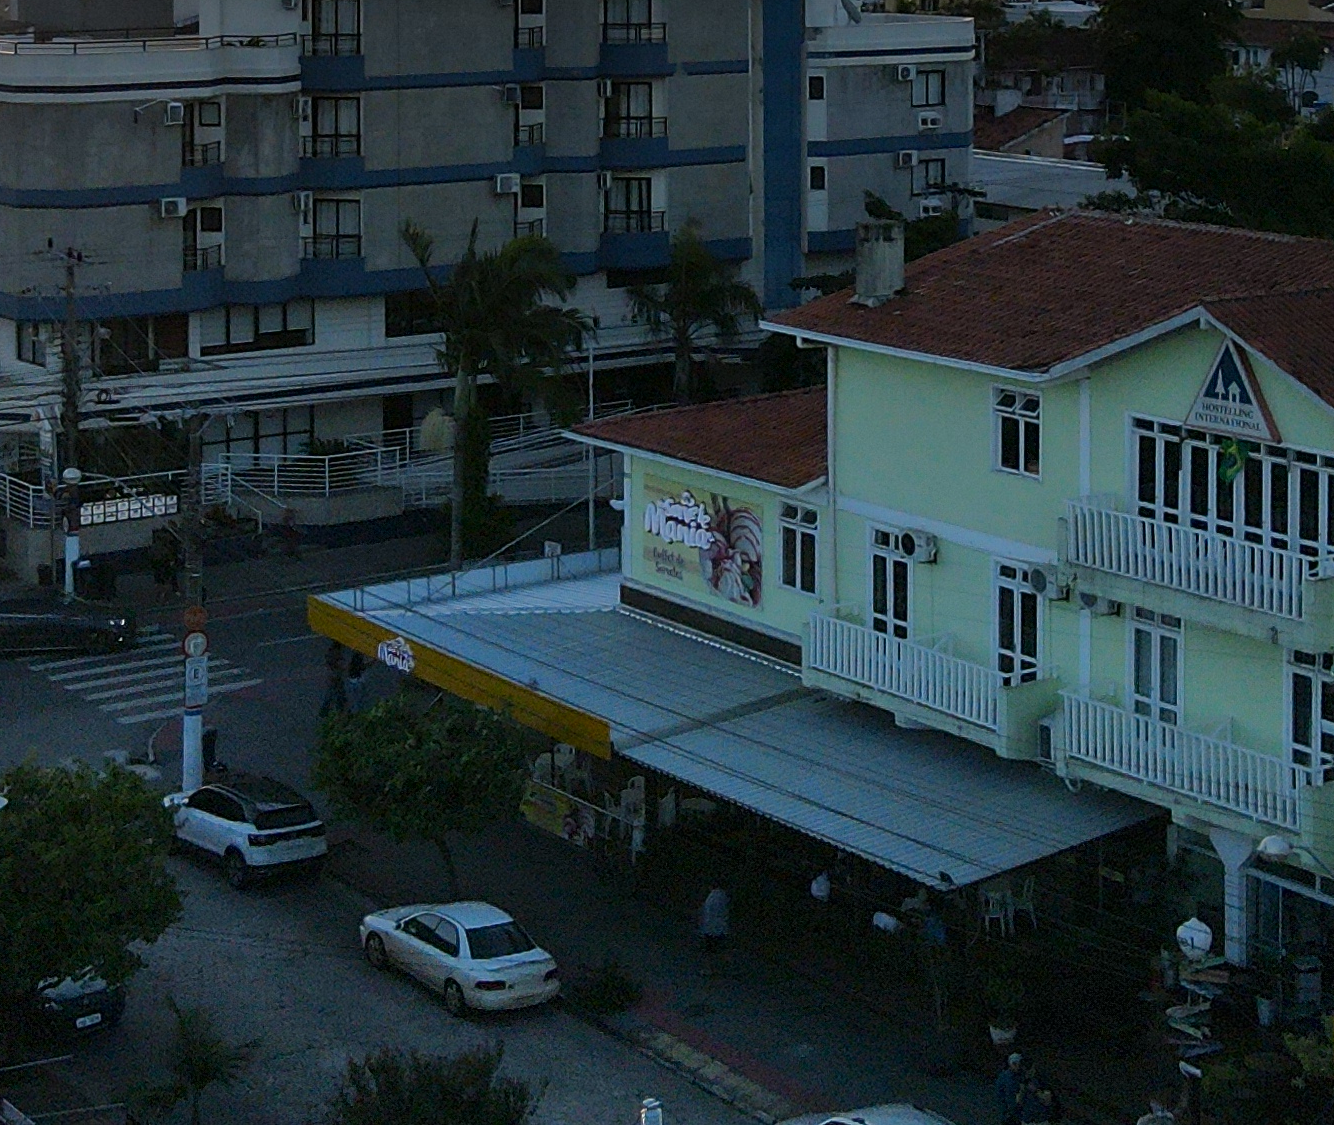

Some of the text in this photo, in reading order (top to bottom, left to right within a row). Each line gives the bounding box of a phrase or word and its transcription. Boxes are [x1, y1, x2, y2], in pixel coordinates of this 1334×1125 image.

[1201, 402, 1254, 419] HOSTELLING
[1195, 412, 1261, 431] INTERNATIONAL
[644, 500, 715, 550] Mania
